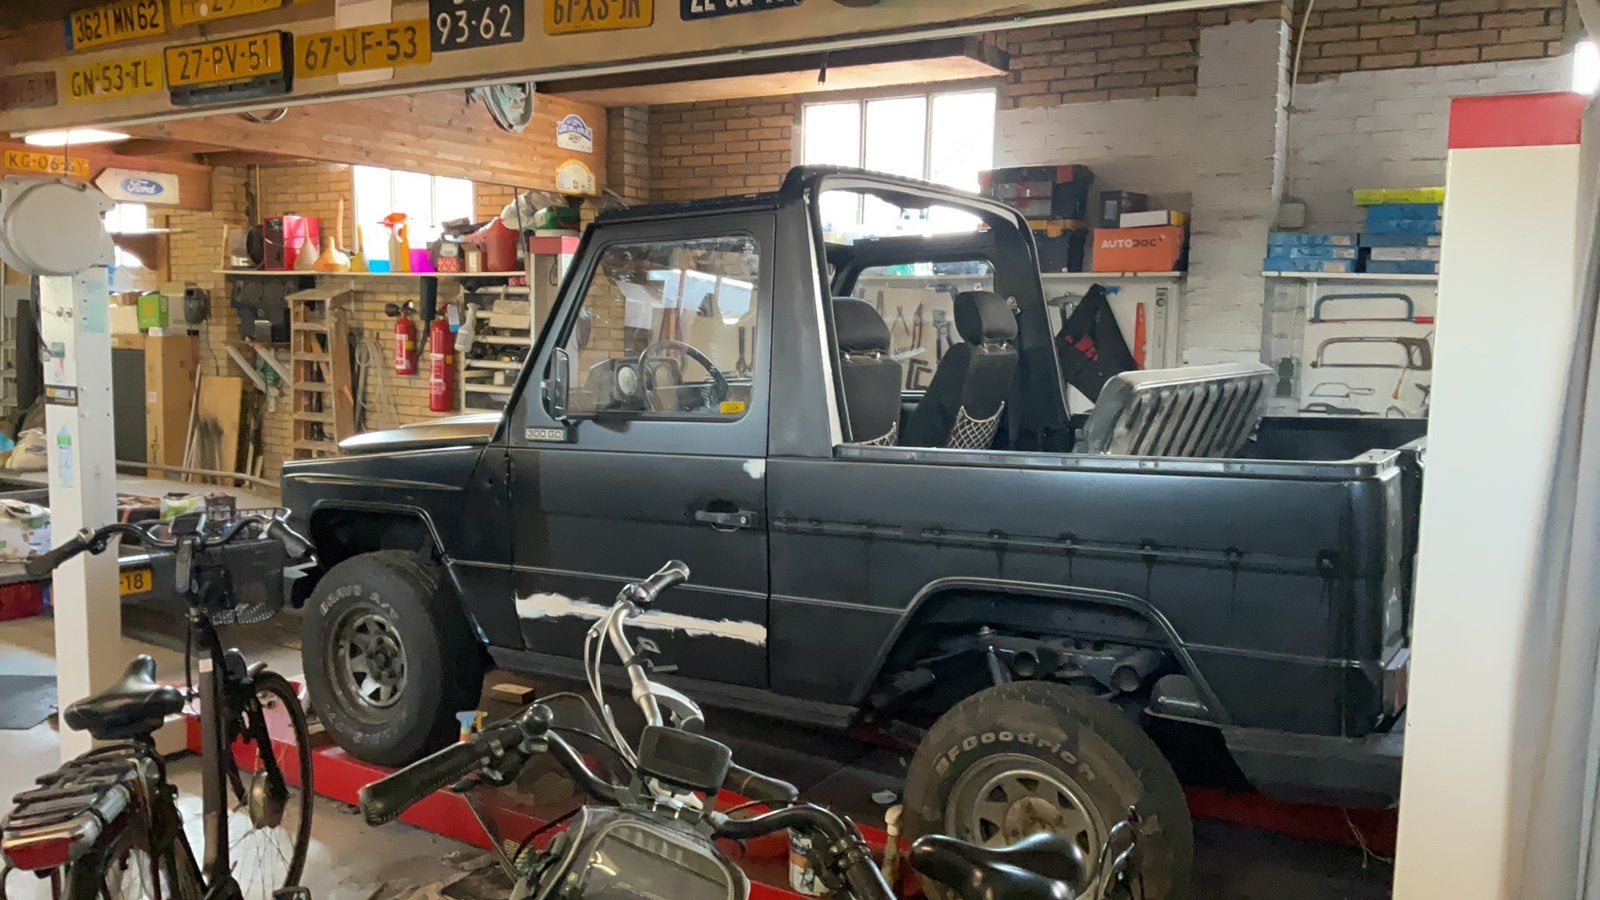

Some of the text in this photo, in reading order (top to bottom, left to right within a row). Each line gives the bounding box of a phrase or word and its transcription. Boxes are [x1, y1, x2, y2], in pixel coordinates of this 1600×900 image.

[177, 38, 272, 81] 27-PV-51
[304, 26, 419, 71] 67-UF-53
[71, 60, 154, 97] GN-53-TL
[126, 179, 156, 195] Ford
[1101, 238, 1157, 249] AUTODOC
[527, 430, 546, 438] 300
